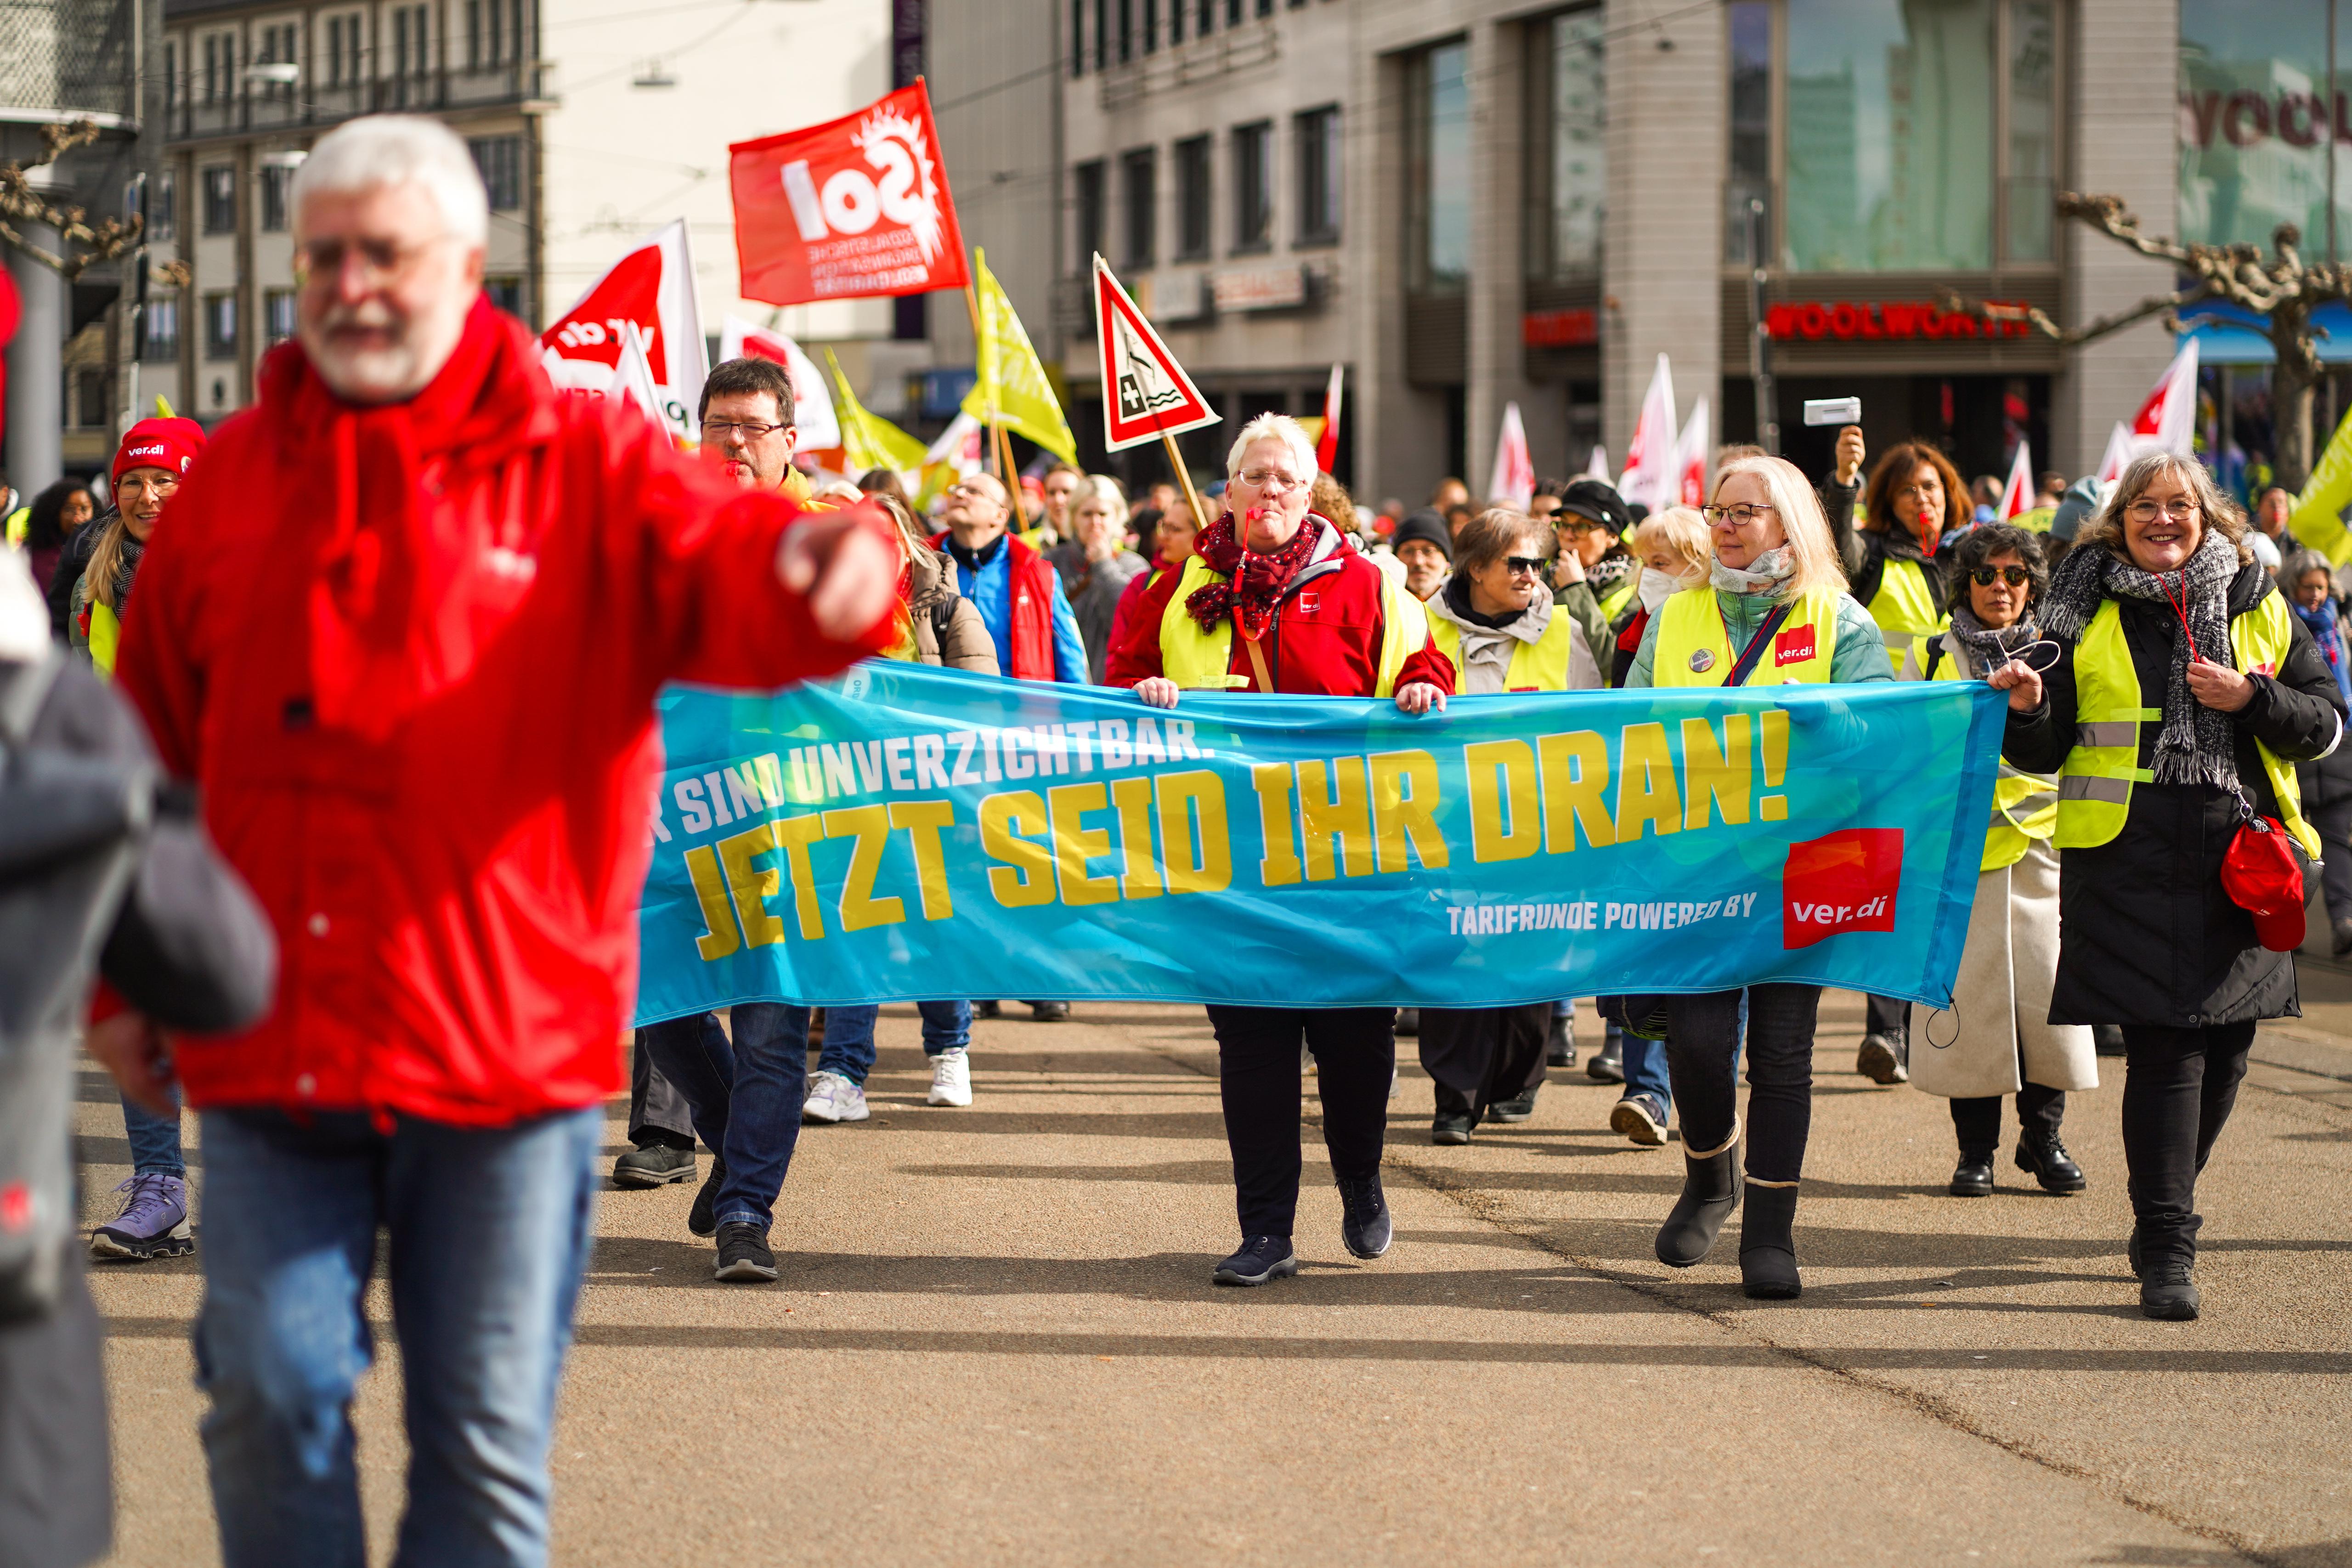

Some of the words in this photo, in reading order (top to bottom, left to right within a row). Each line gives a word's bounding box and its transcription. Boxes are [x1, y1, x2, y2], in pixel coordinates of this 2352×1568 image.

[128, 445, 164, 456] ver.di
[1778, 646, 1813, 660] ver.di
[673, 752, 785, 834] SIND
[790, 719, 1214, 802] UNVERZICHTBAR.
[684, 799, 955, 961] JETZT
[978, 770, 1233, 908] SEID
[1251, 748, 1450, 888] IHR
[1464, 709, 1789, 865] DRAN!
[1447, 902, 1598, 935] TARIFRUNDE
[1604, 900, 1723, 930] POWERED
[1723, 892, 1757, 917] BY
[1792, 895, 1888, 924] ver.di
